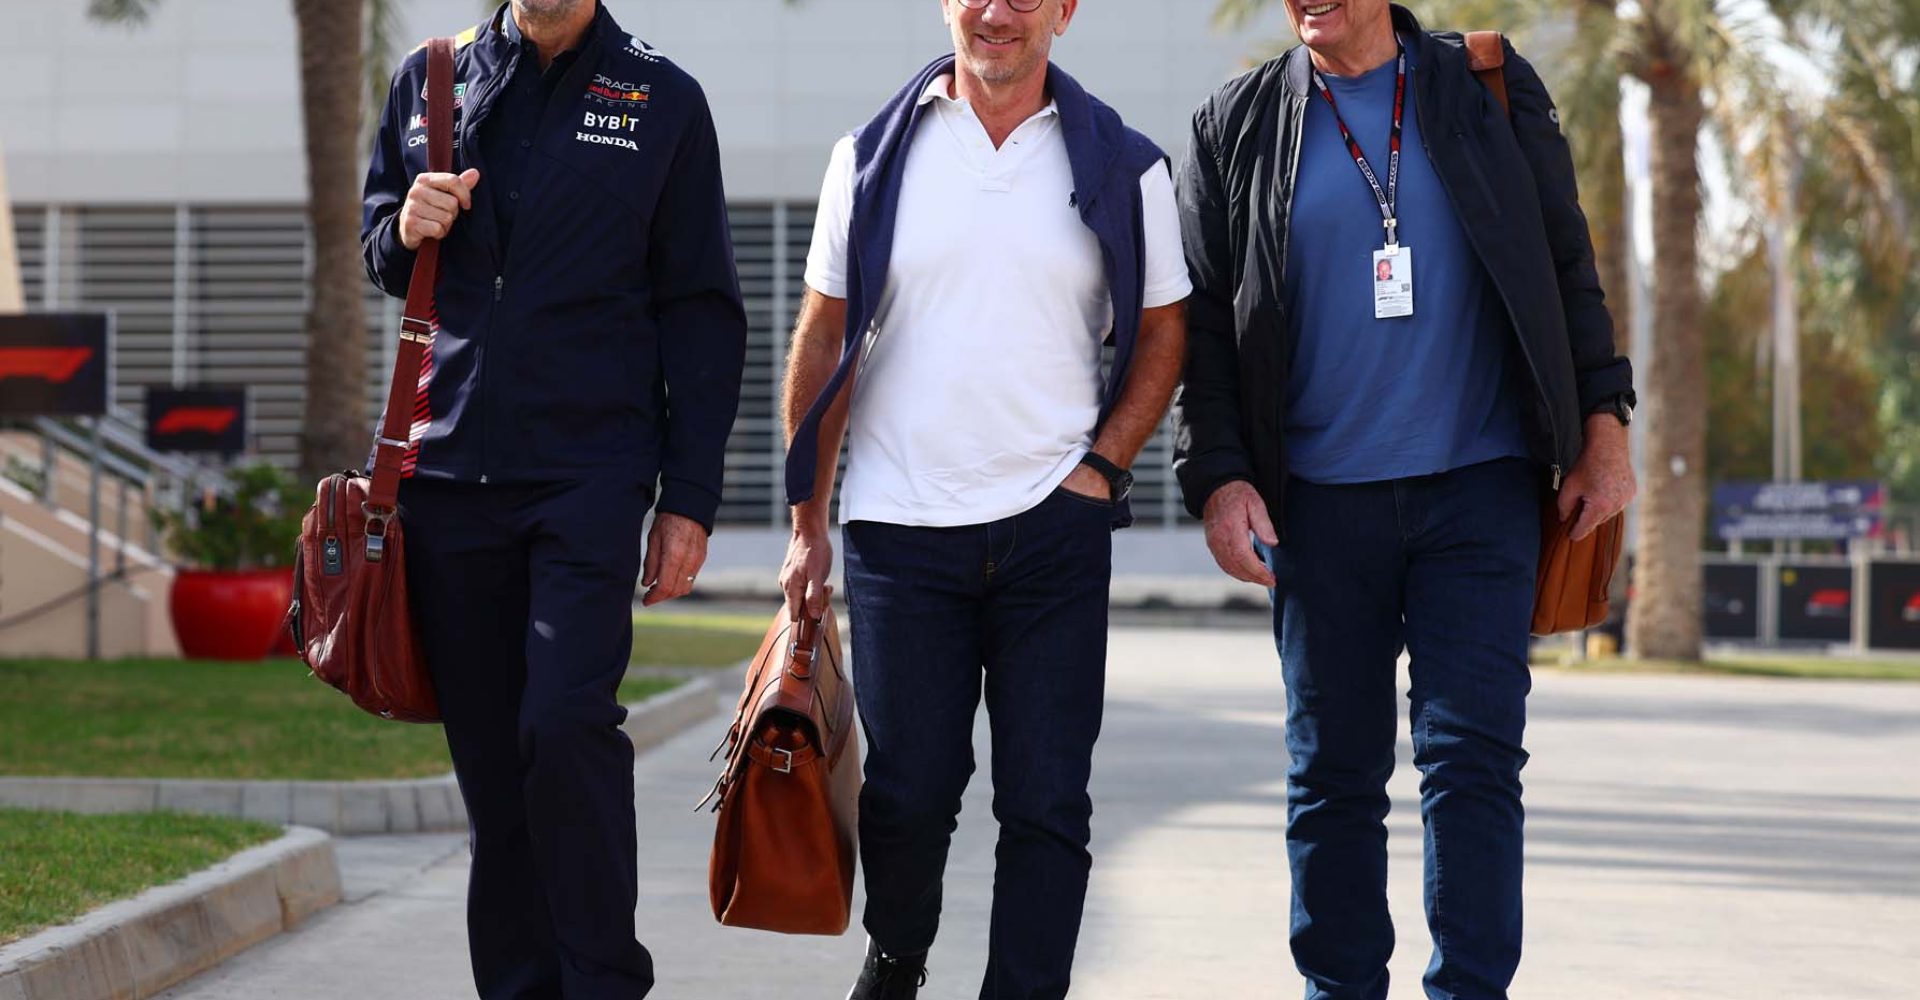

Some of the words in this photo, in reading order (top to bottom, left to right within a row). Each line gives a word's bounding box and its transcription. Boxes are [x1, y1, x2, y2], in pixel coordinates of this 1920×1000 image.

[593, 74, 651, 92] ORACLE
[583, 111, 639, 132] BYBIT
[575, 131, 639, 151] HONDA
